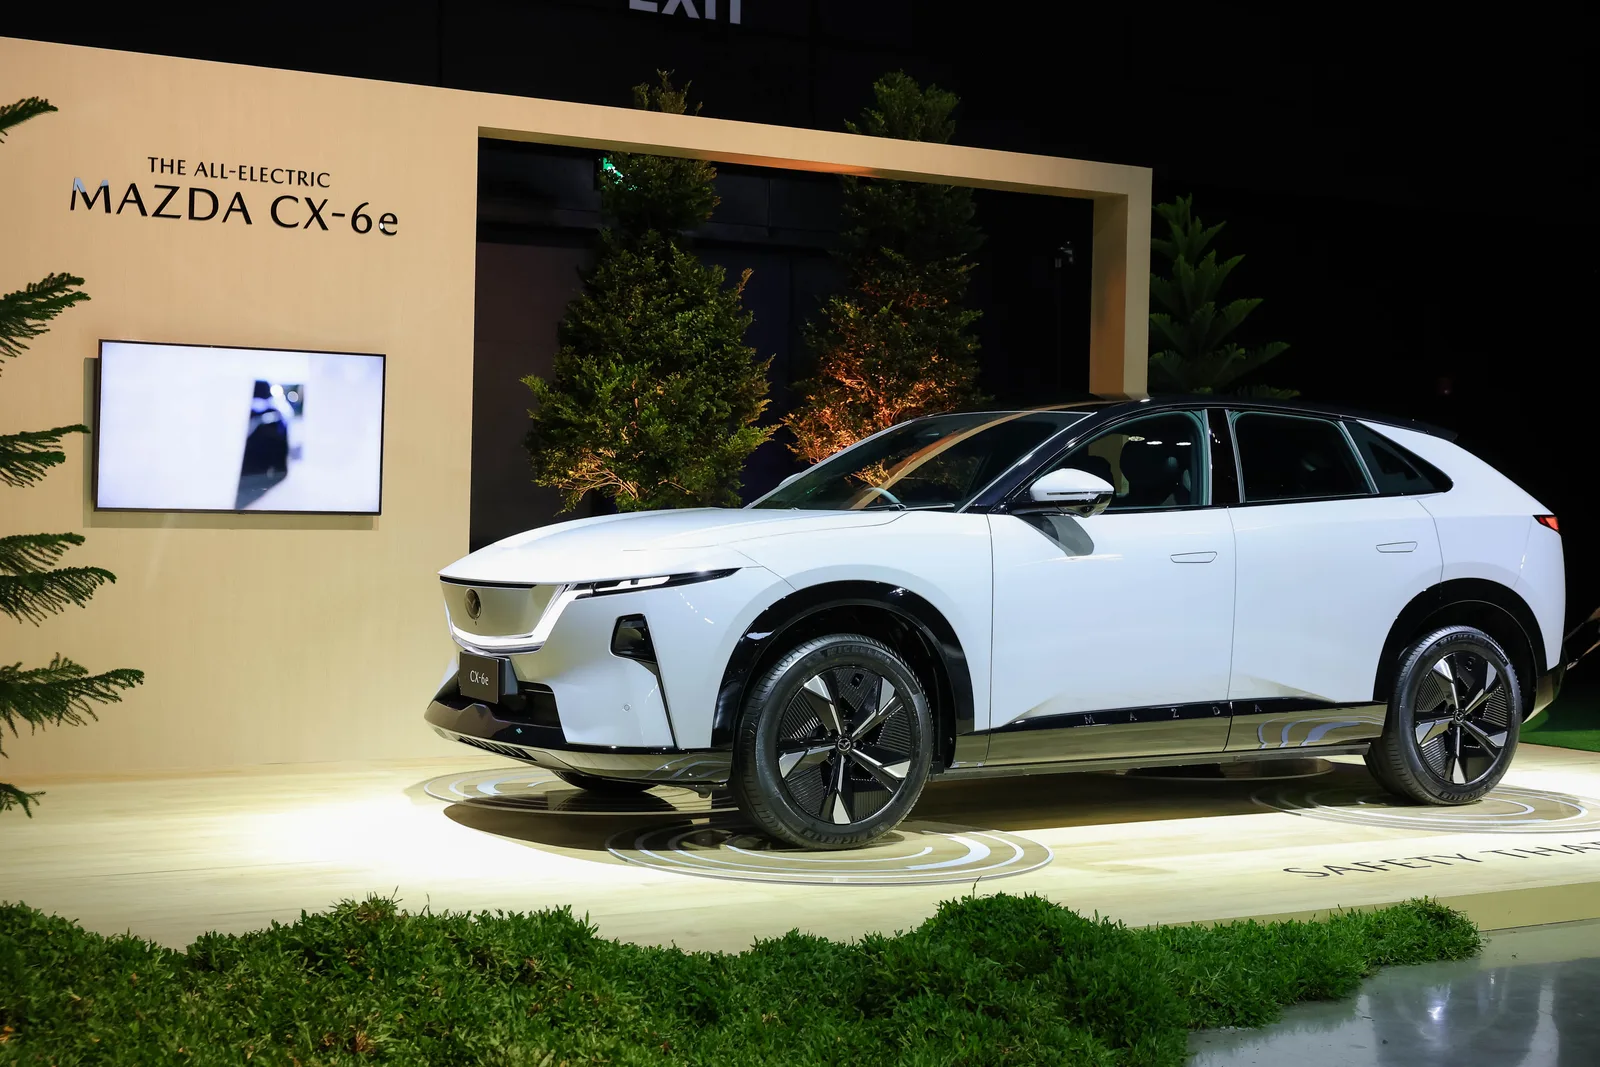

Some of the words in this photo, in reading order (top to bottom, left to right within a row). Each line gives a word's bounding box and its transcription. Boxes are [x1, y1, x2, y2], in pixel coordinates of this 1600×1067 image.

[147, 157, 187, 176] THE
[194, 161, 331, 188] ALL-ELECTRIC
[70, 177, 253, 225] MAZDA
[270, 195, 398, 236] CX-6e
[470, 670, 489, 686] CX-6e
[1084, 704, 1262, 725] MAZDA
[1283, 853, 1483, 878] SAFETY
